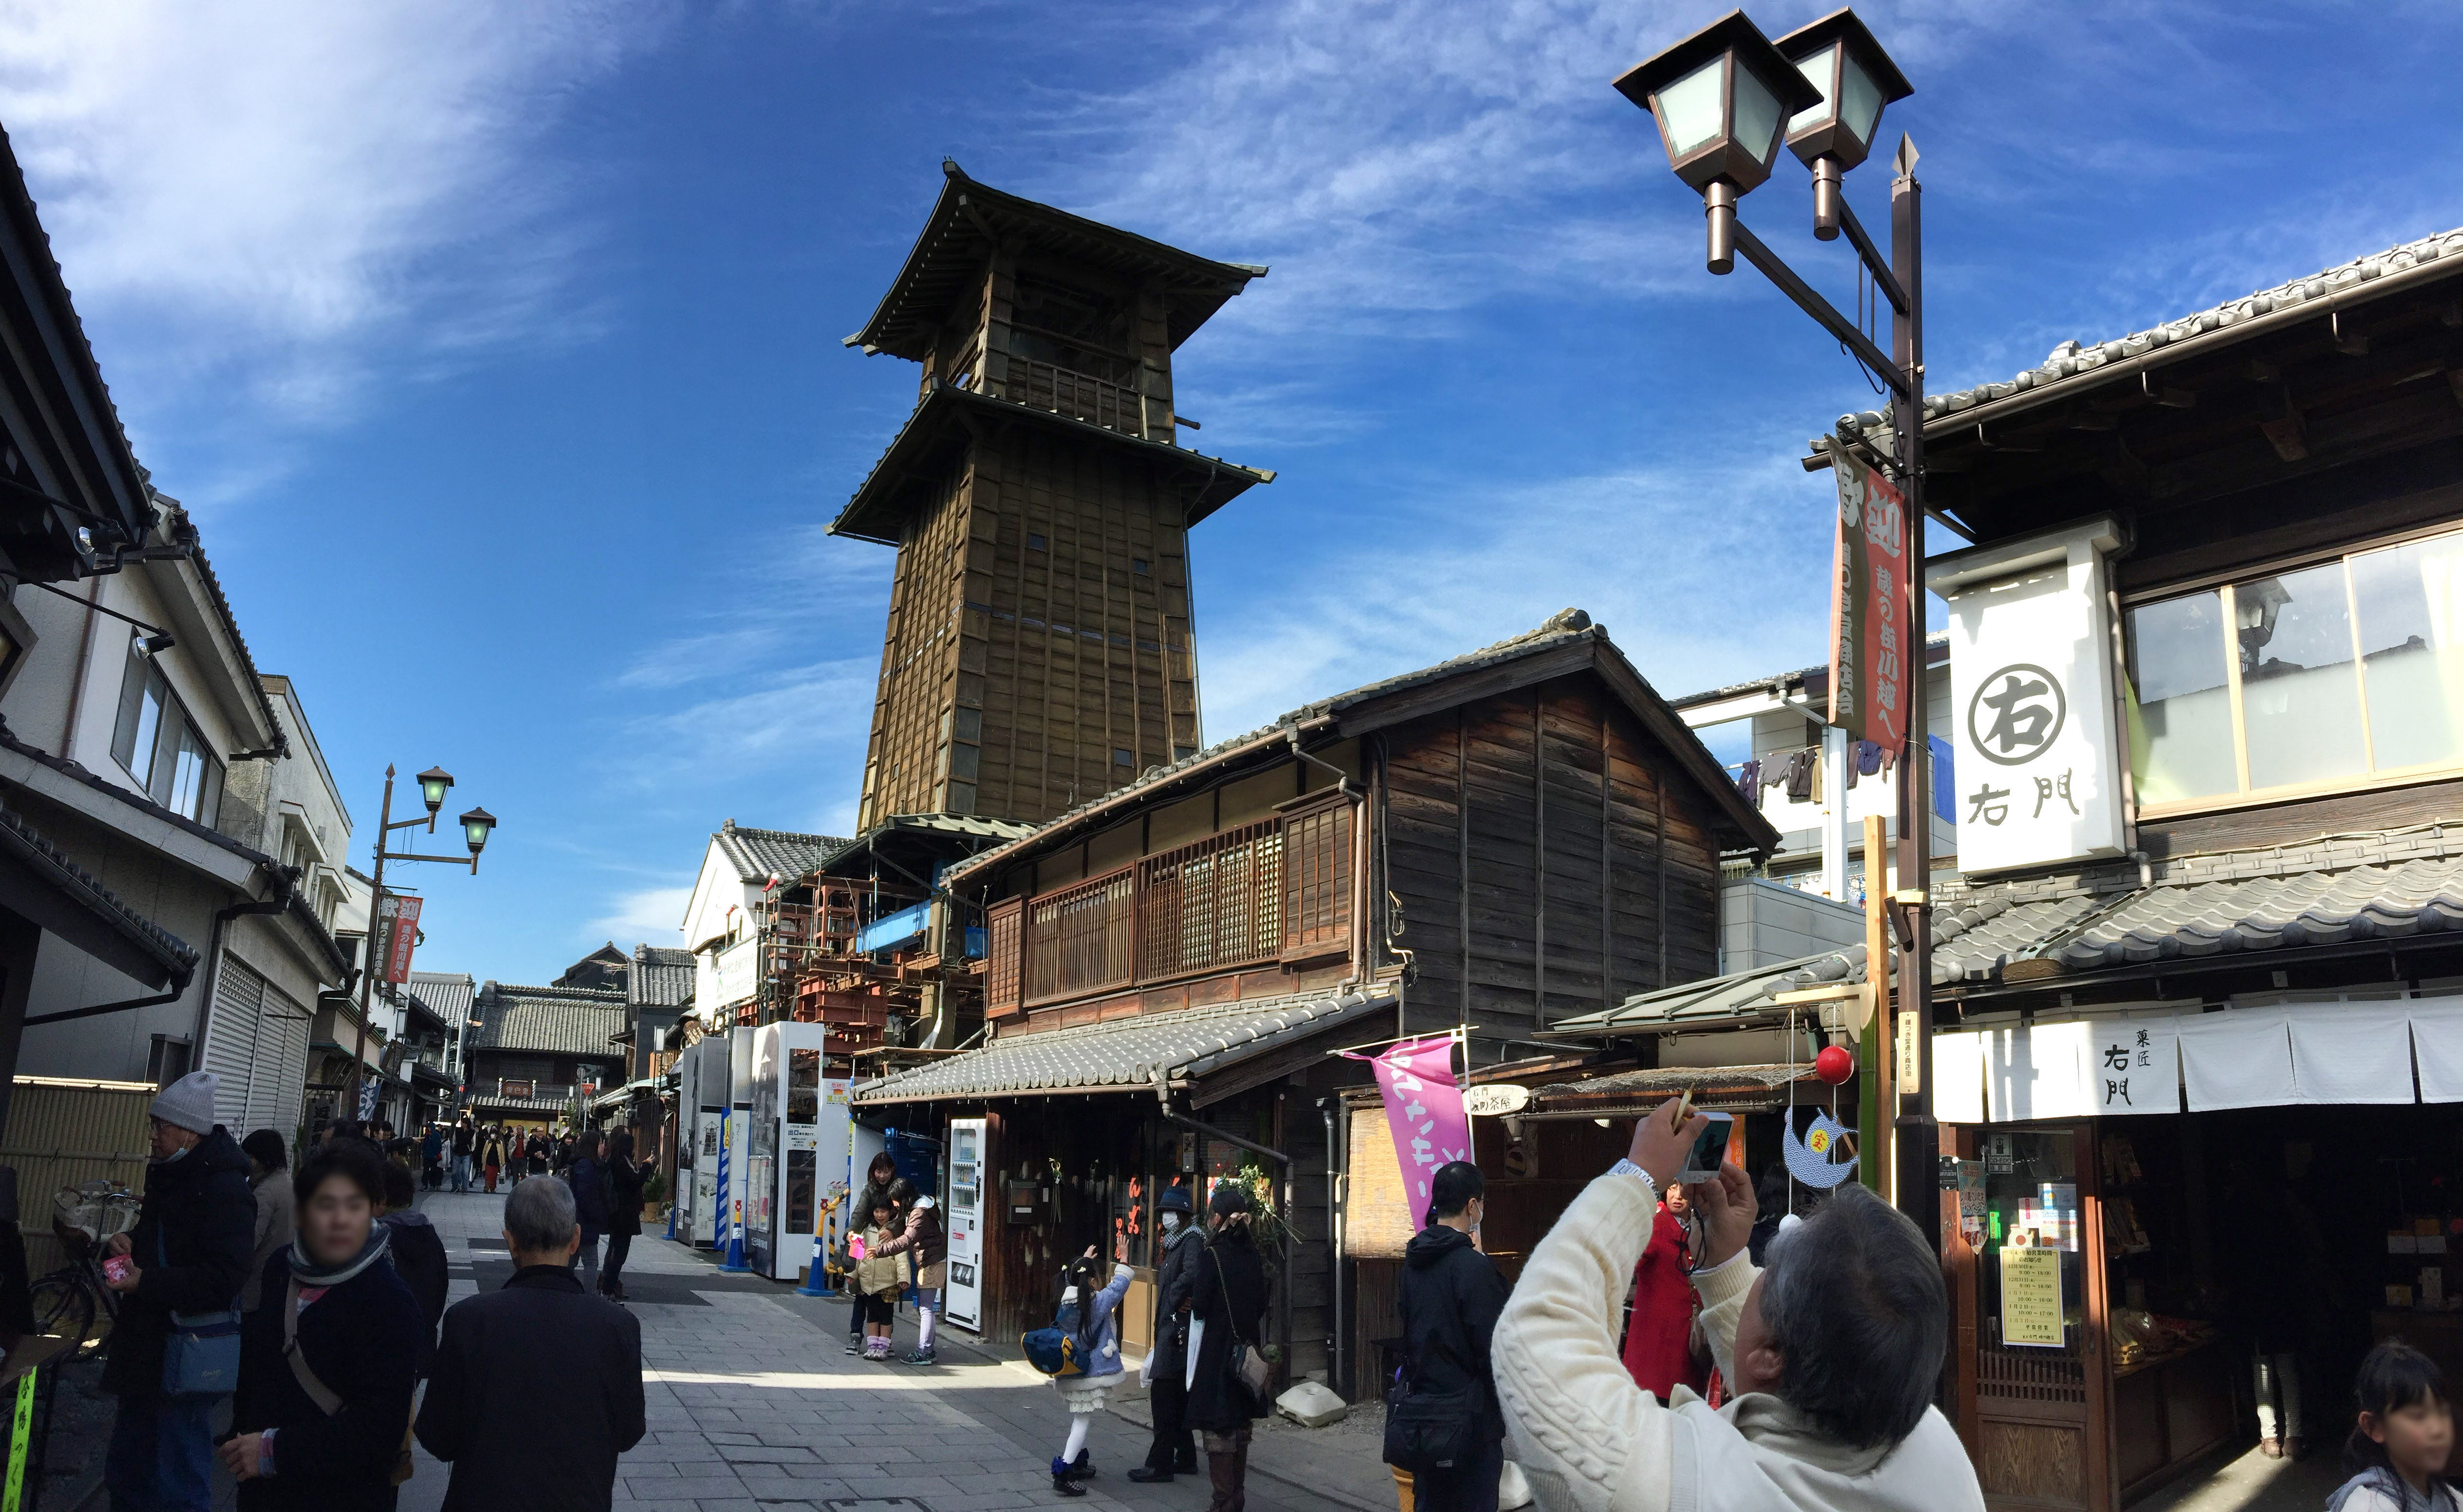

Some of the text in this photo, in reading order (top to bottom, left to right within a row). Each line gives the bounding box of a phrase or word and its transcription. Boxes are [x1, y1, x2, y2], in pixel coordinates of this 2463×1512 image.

[1876, 564, 1897, 739] 蔵の街川越へ
[1967, 767, 2080, 827] 右門
[380, 898, 420, 921] 歓迎
[394, 924, 412, 979] 蔵の街川越へ
[2104, 1044, 2132, 1106] 右門
[2136, 1028, 2151, 1067] 菓匠
[1812, 1132, 1827, 1151] 宝
